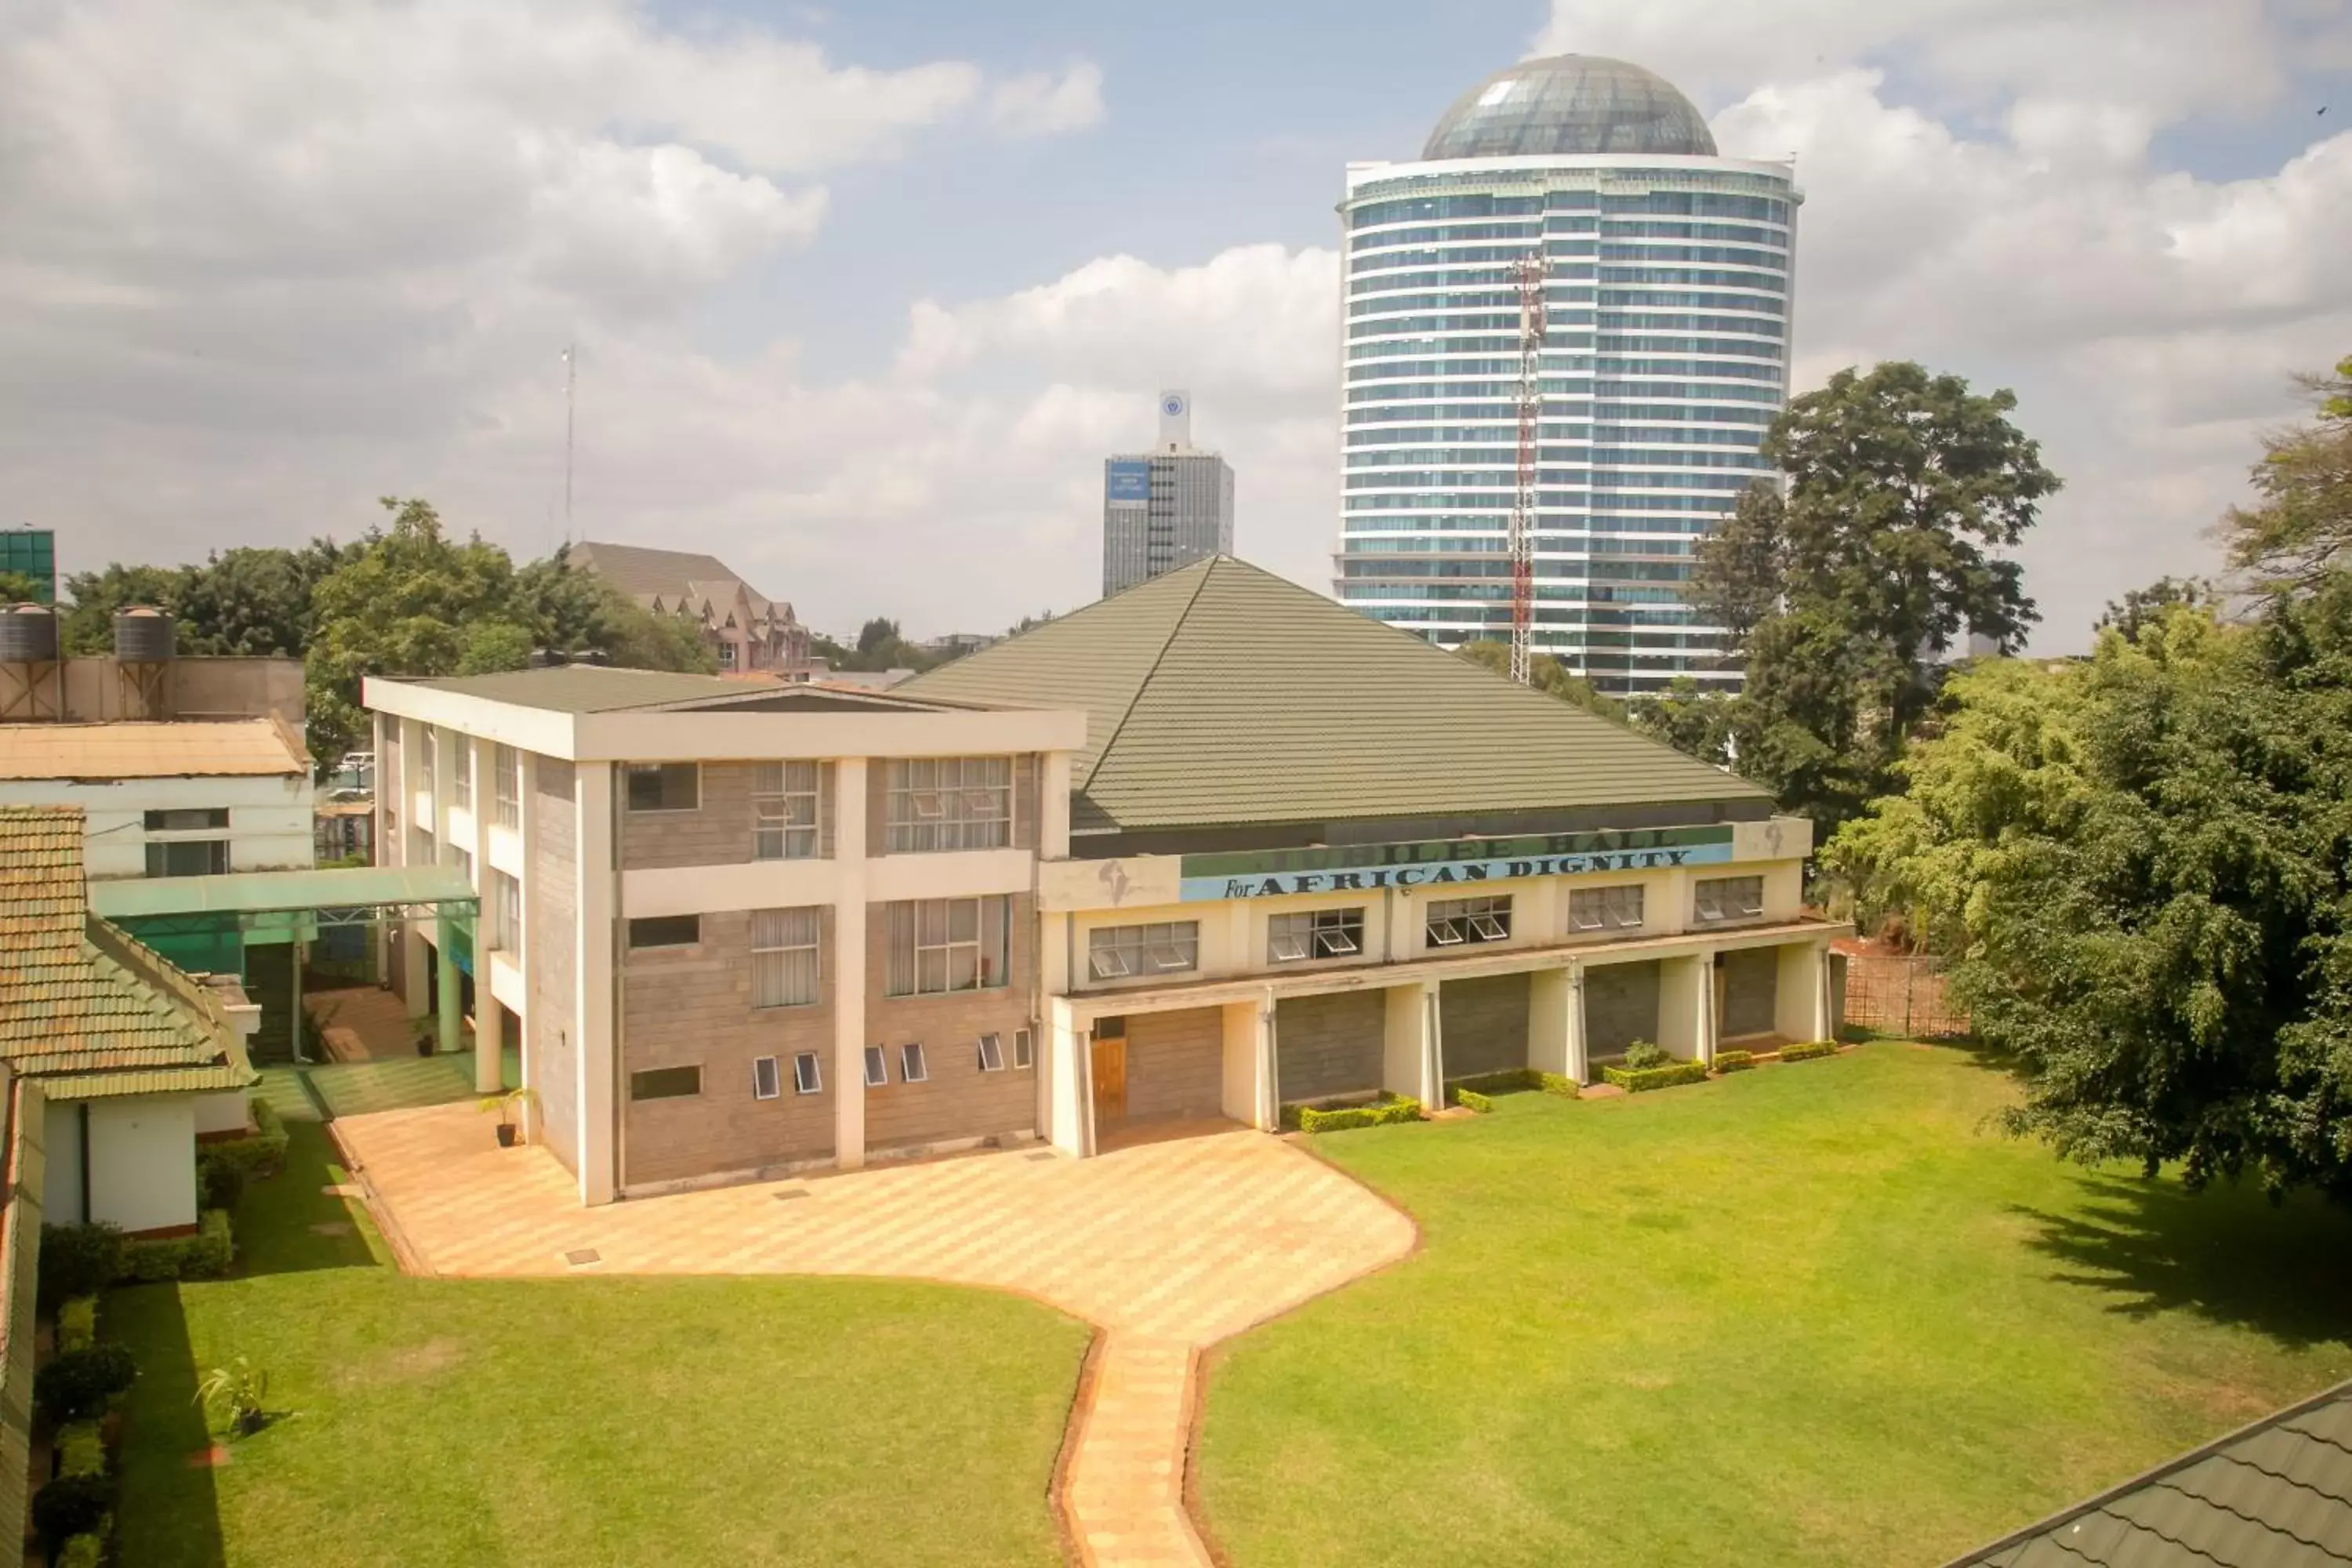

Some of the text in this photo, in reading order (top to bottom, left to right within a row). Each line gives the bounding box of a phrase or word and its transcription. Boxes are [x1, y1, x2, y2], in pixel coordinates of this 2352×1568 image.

[1544, 829, 1678, 855] HALL
[1224, 851, 1692, 898] For AFRICAN DIGNITY
